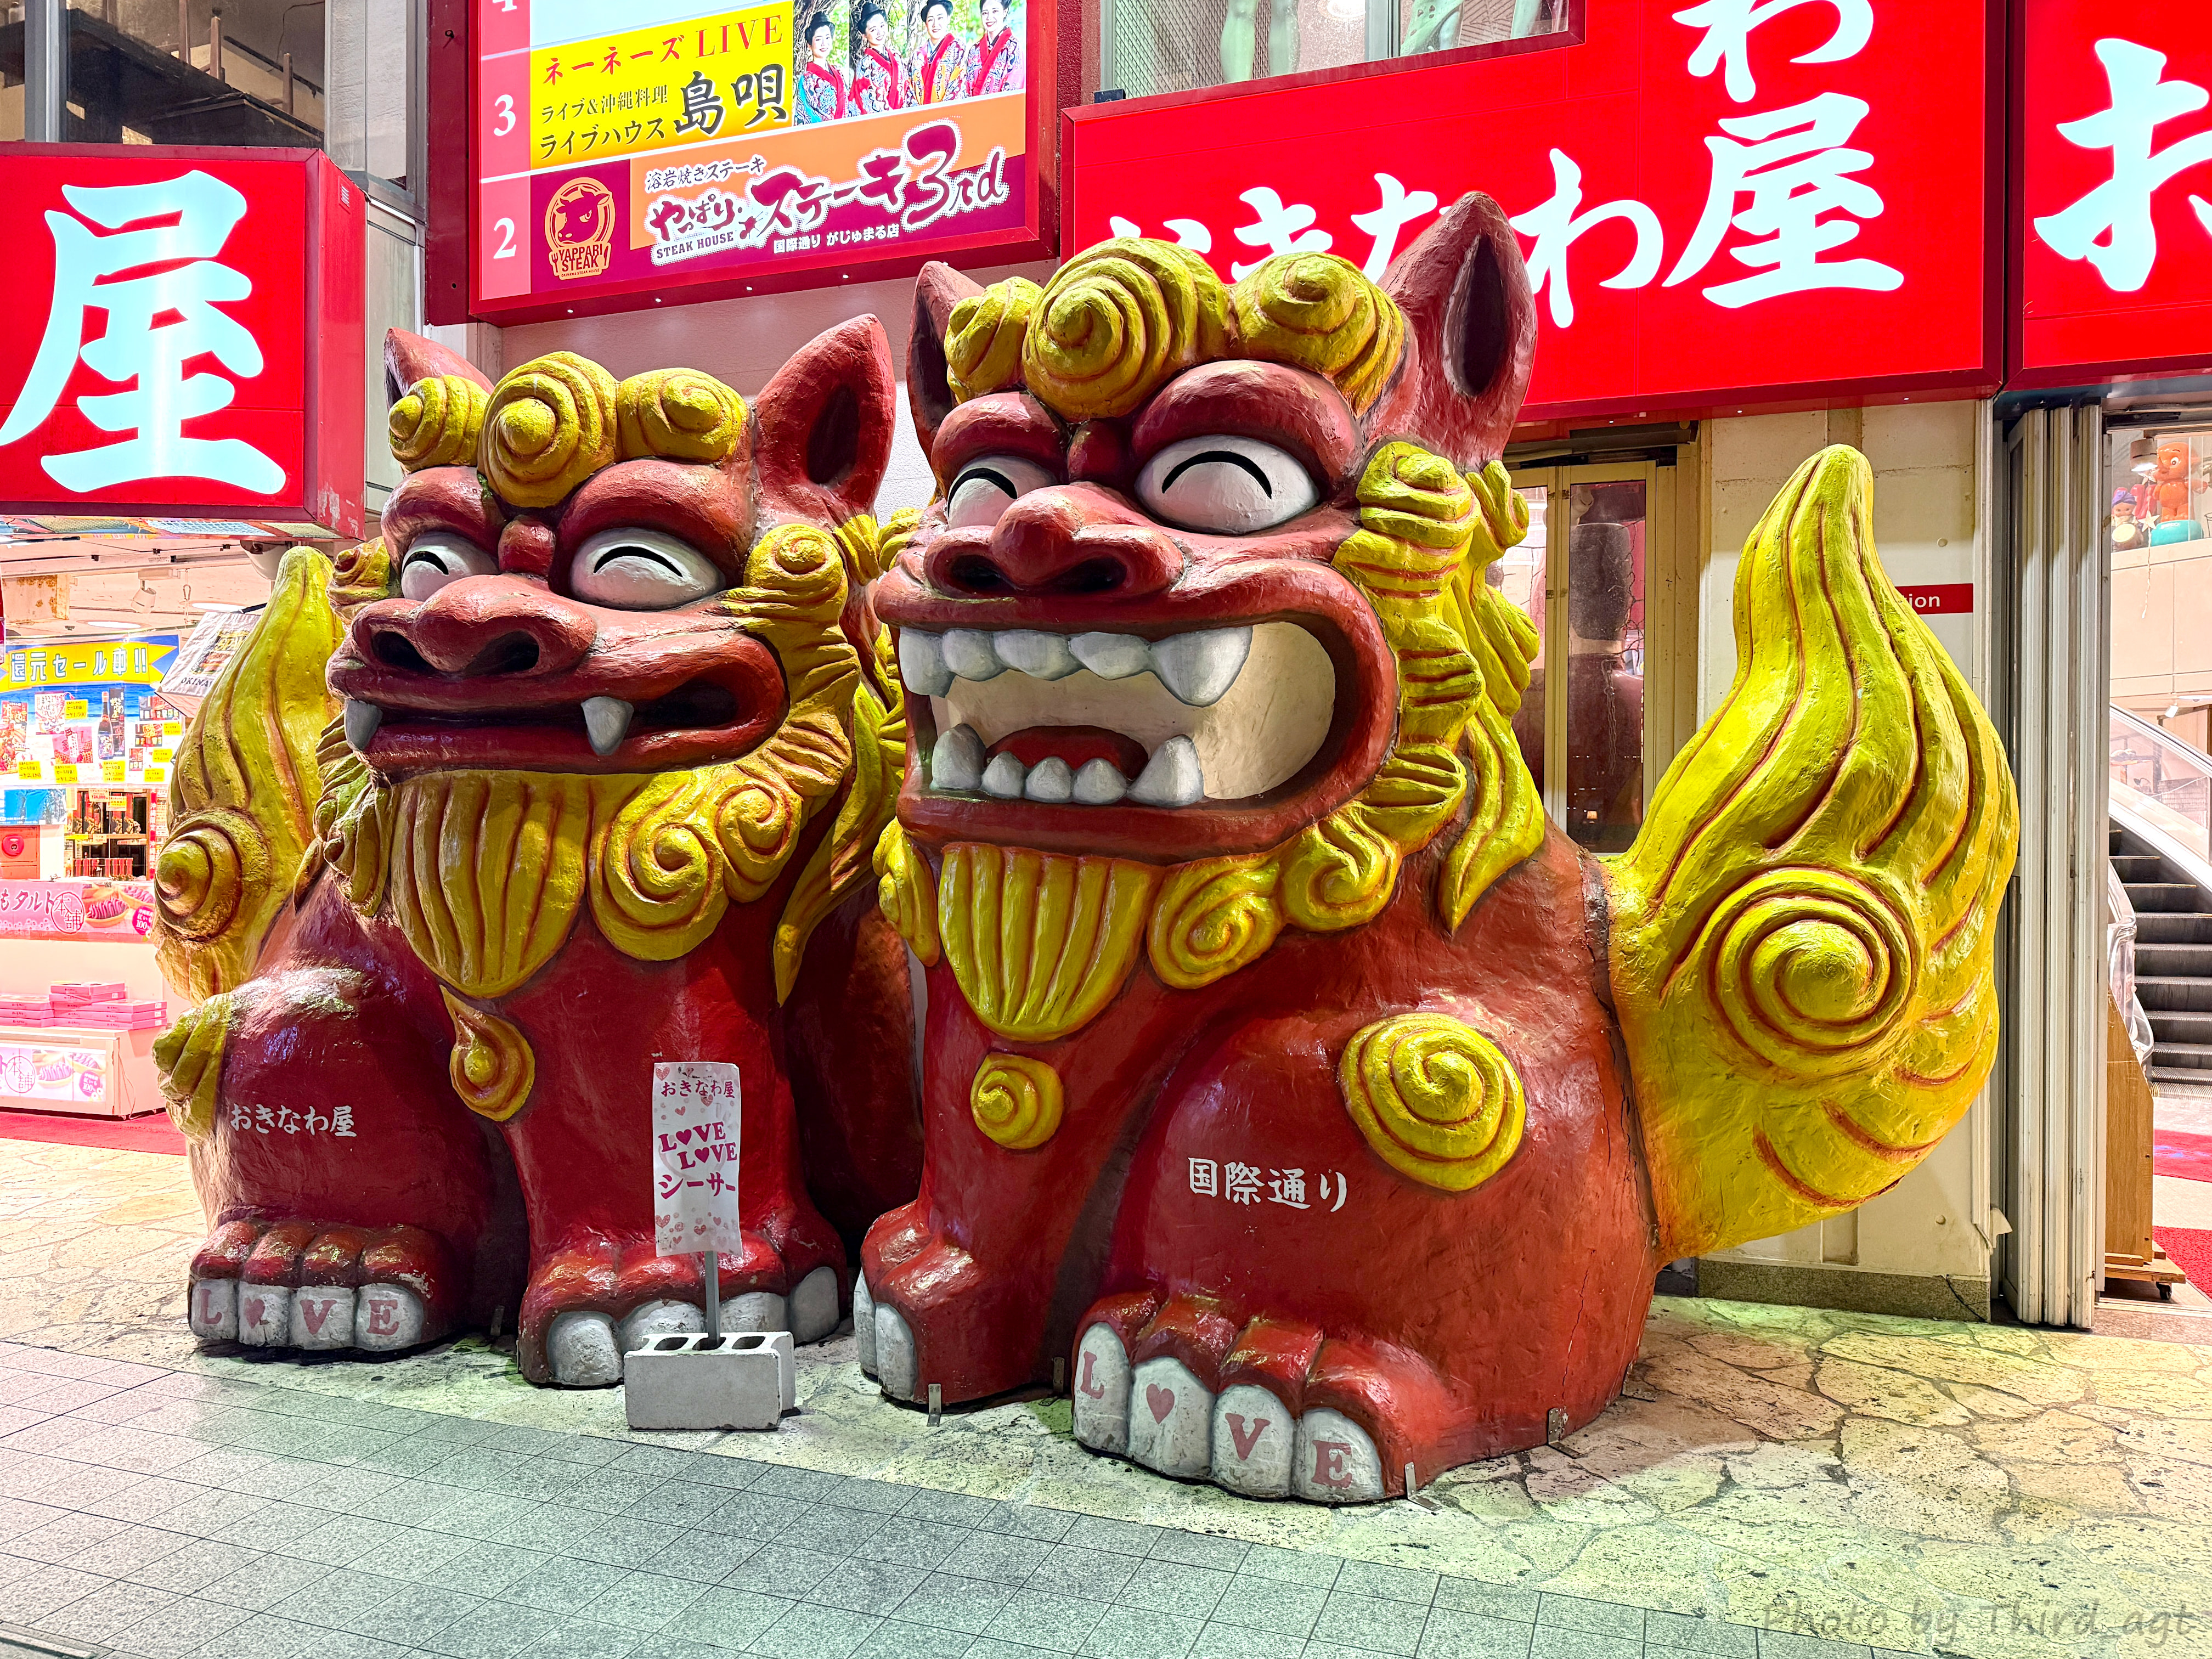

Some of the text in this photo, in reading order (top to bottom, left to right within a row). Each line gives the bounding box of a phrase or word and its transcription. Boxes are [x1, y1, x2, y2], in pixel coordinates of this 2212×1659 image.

[543, 15, 783, 86] ネーネーズ LIVE
[493, 94, 516, 137] 3
[540, 64, 787, 160] ライブハウス 島唄
[541, 84, 668, 124] ライブ&沖縄料理
[647, 157, 764, 190] 溶岩焼きステーキ
[493, 217, 517, 259] 2
[558, 243, 602, 261] YAPPARI
[656, 231, 734, 259] STEAK HOUSE
[774, 223, 900, 254] 国際通り がじゅまる店
[562, 255, 599, 272] STEAK
[0, 170, 286, 494] 屋
[1905, 593, 1940, 608] ion
[661, 1080, 735, 1098] おきなわ屋
[230, 1104, 357, 1137] おきなわ屋
[658, 1172, 736, 1199] シーサー
[1188, 1157, 1347, 1212] 国際通り
